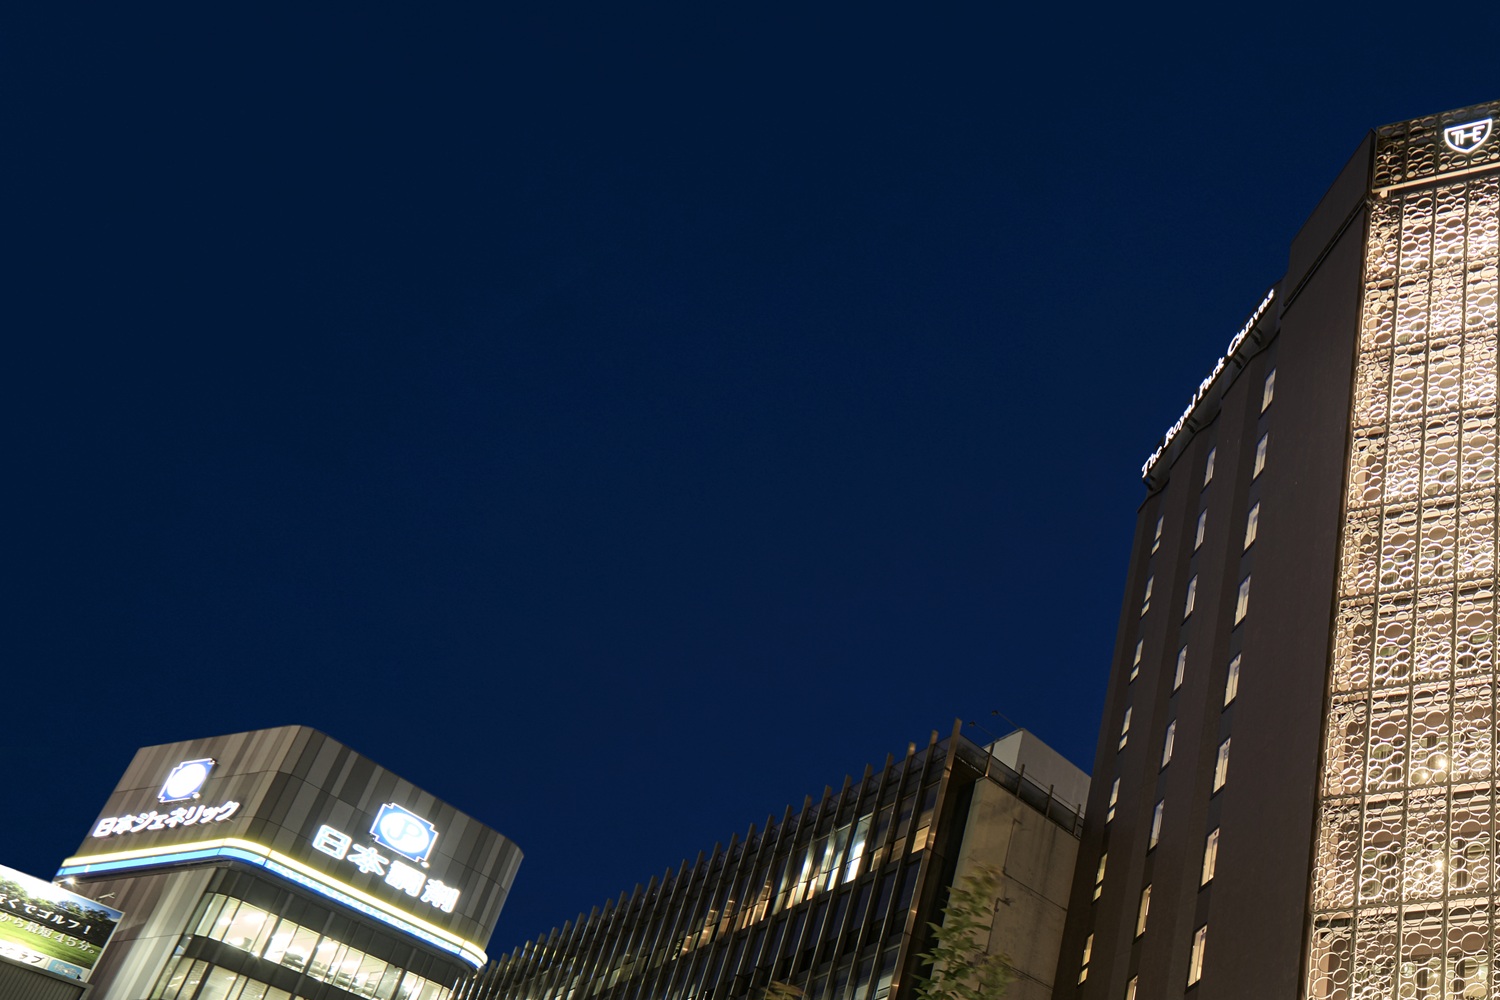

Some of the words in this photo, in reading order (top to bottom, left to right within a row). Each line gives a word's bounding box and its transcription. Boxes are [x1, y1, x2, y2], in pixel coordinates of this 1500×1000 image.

[1451, 125, 1485, 145] THE
[1141, 446, 1163, 479] The
[1164, 394, 1197, 448] Royal
[1197, 356, 1226, 401] Park
[1227, 289, 1275, 357] Canvas
[92, 800, 240, 838] 日本ジェネリック
